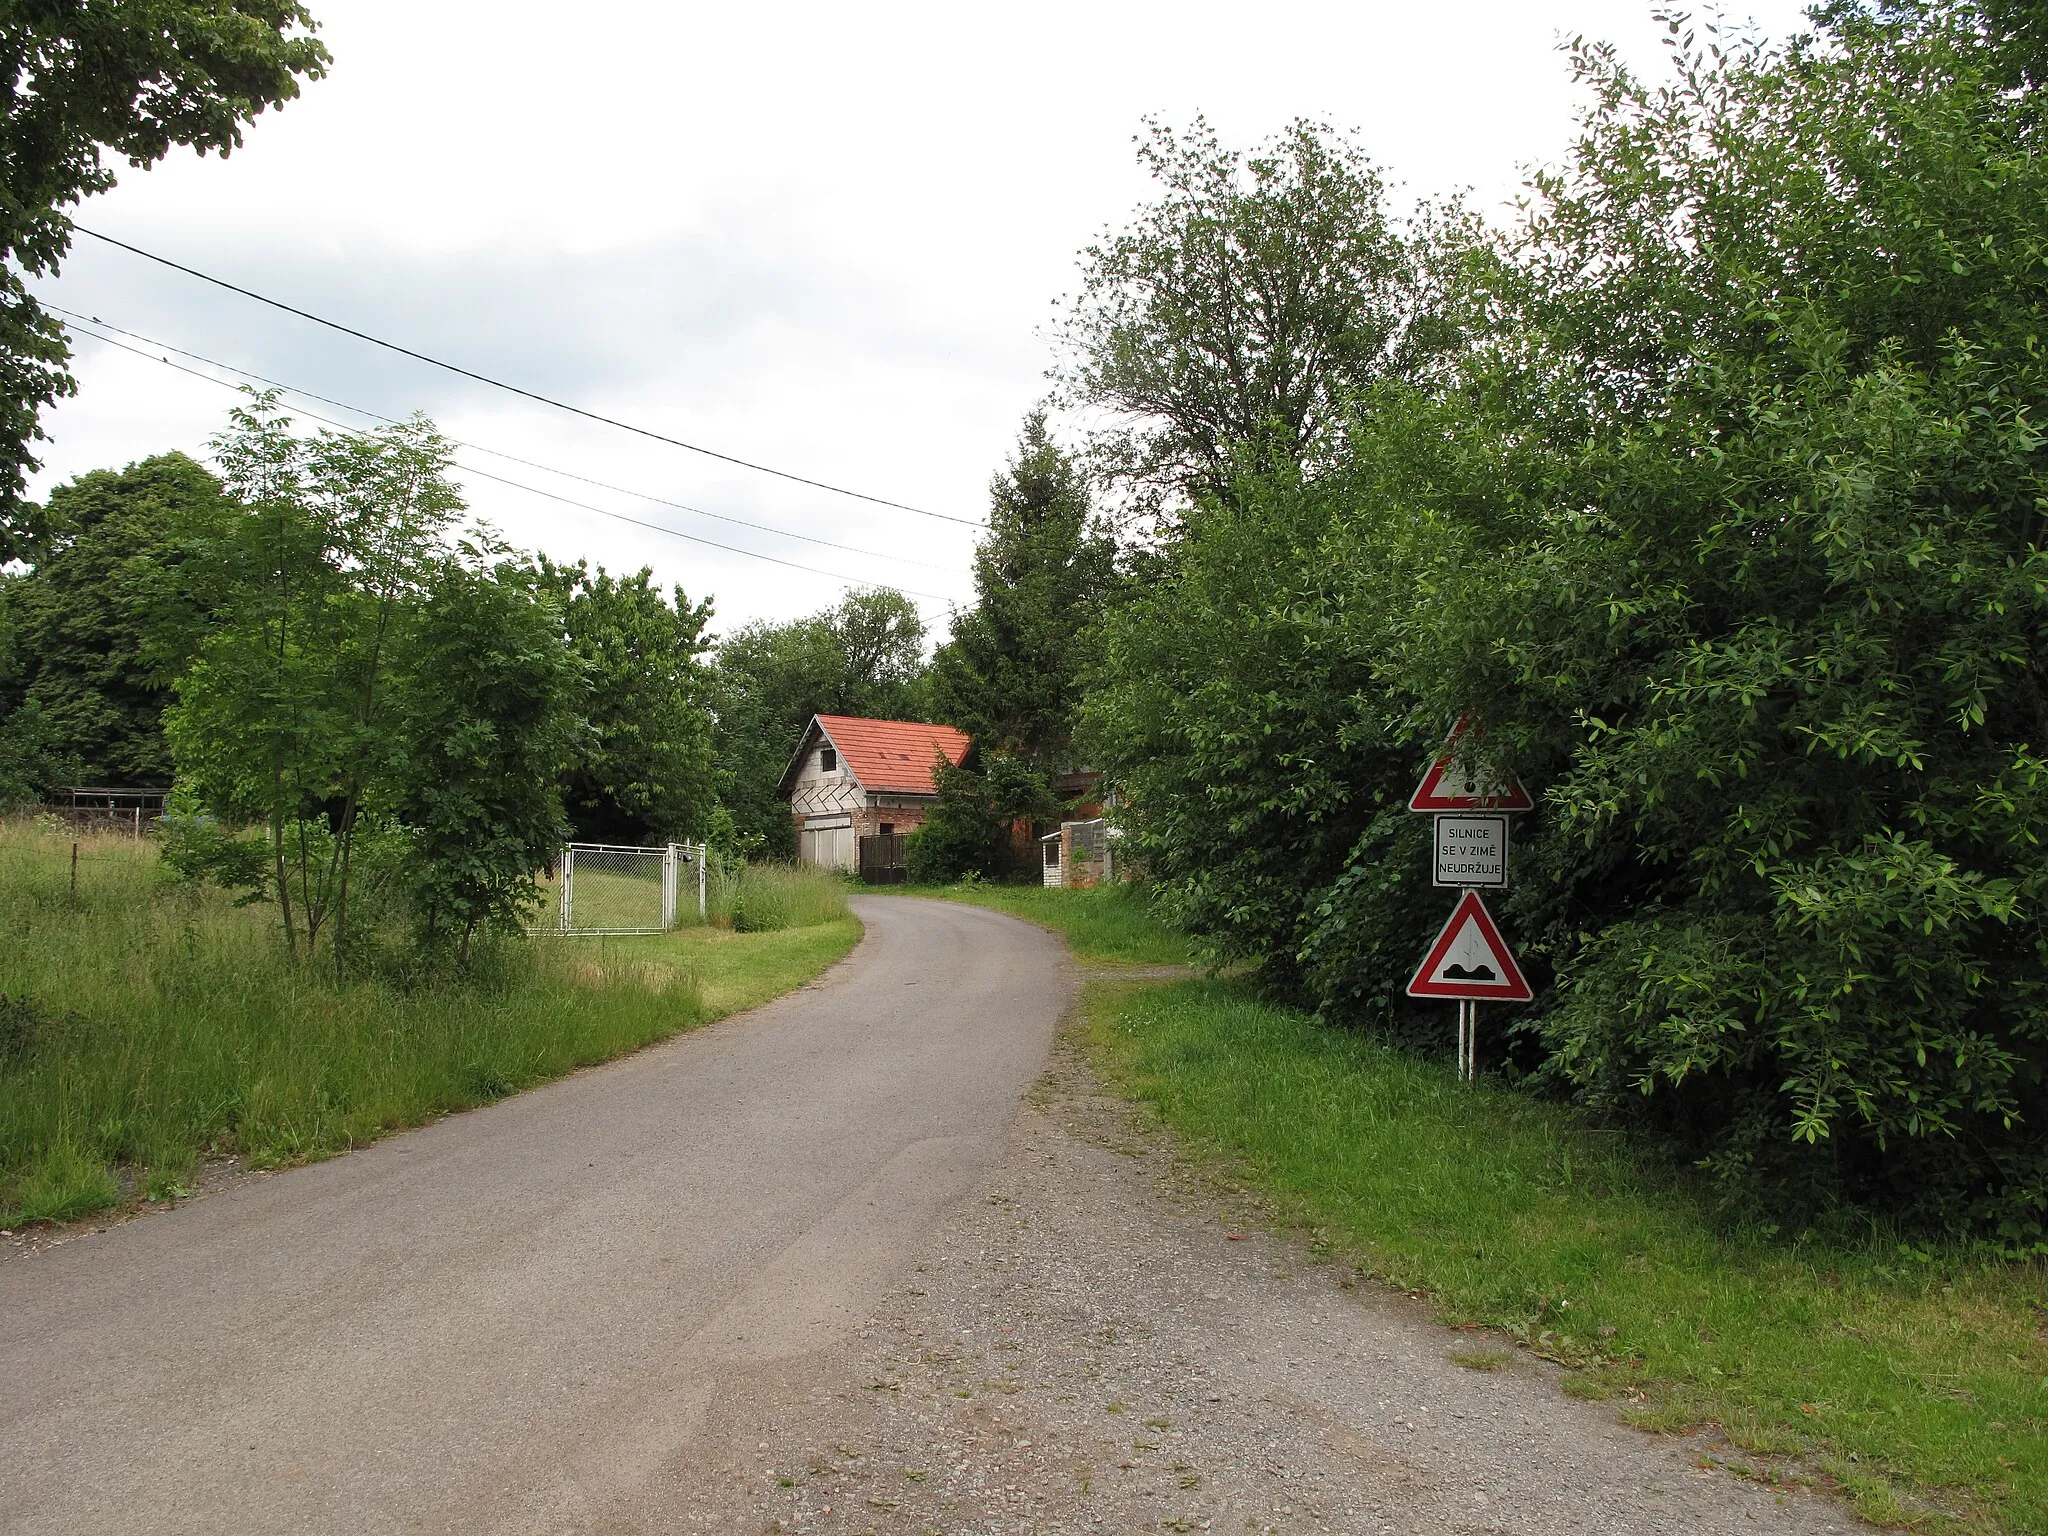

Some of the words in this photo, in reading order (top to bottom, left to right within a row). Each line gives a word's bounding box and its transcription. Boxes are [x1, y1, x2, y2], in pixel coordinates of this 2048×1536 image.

[1449, 829, 1489, 839] SILNICE
[1442, 846, 1456, 855] SE
[1459, 846, 1466, 855] V
[1470, 844, 1496, 856] ZIMĚ
[1439, 862, 1501, 874] NEUDRŽUJE
